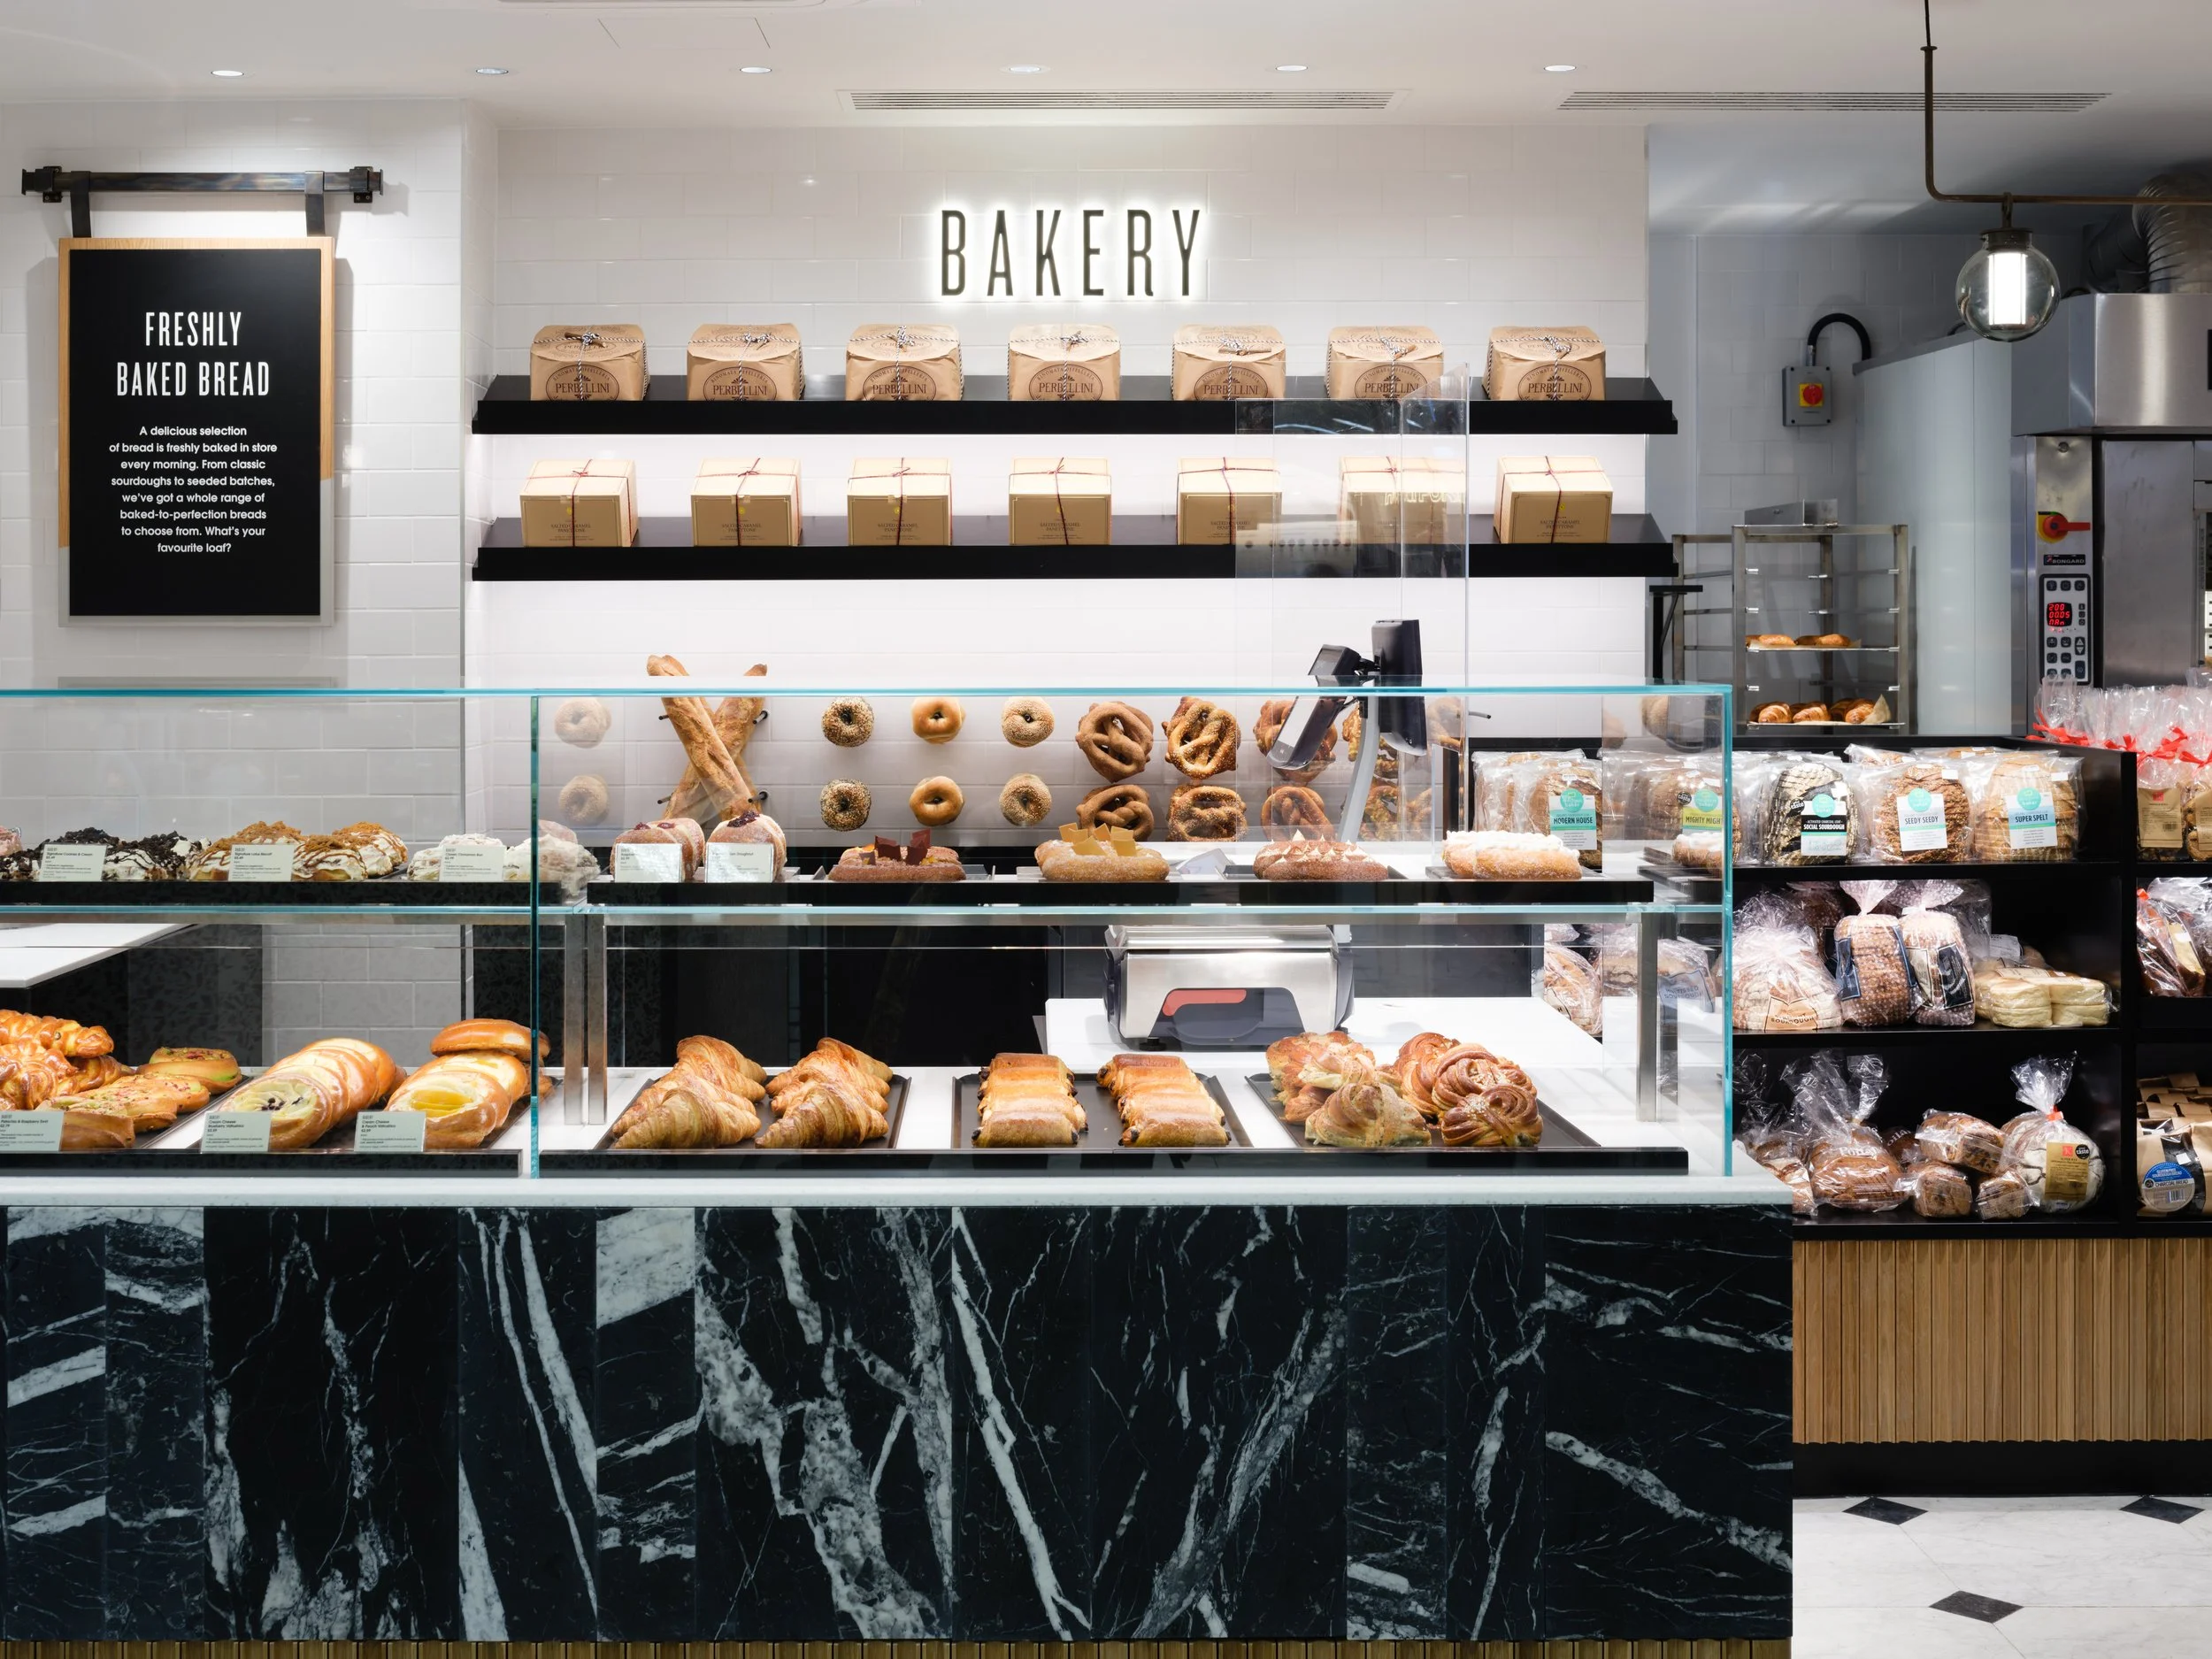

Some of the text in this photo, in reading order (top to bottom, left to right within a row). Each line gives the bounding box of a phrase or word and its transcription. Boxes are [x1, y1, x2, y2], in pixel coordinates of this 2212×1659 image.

[941, 209, 1201, 296] BAKERY
[145, 311, 242, 347] FRESHLY
[117, 361, 270, 396] BAKED BREAD
[139, 426, 248, 436] A delicious selection
[109, 442, 278, 455] of bread is freshly baked in store
[120, 459, 266, 472] every morning. From classic
[111, 476, 275, 488] sourdoughs to seeded batches,
[121, 493, 154, 503] we've
[156, 493, 174, 505] got
[186, 493, 219, 503] whole
[220, 494, 252, 505] range
[254, 492, 265, 503] of
[119, 509, 267, 521] baked-to-perfection breads
[120, 526, 266, 538] to choose from. What's your
[157, 542, 232, 553] favourite loaf?
